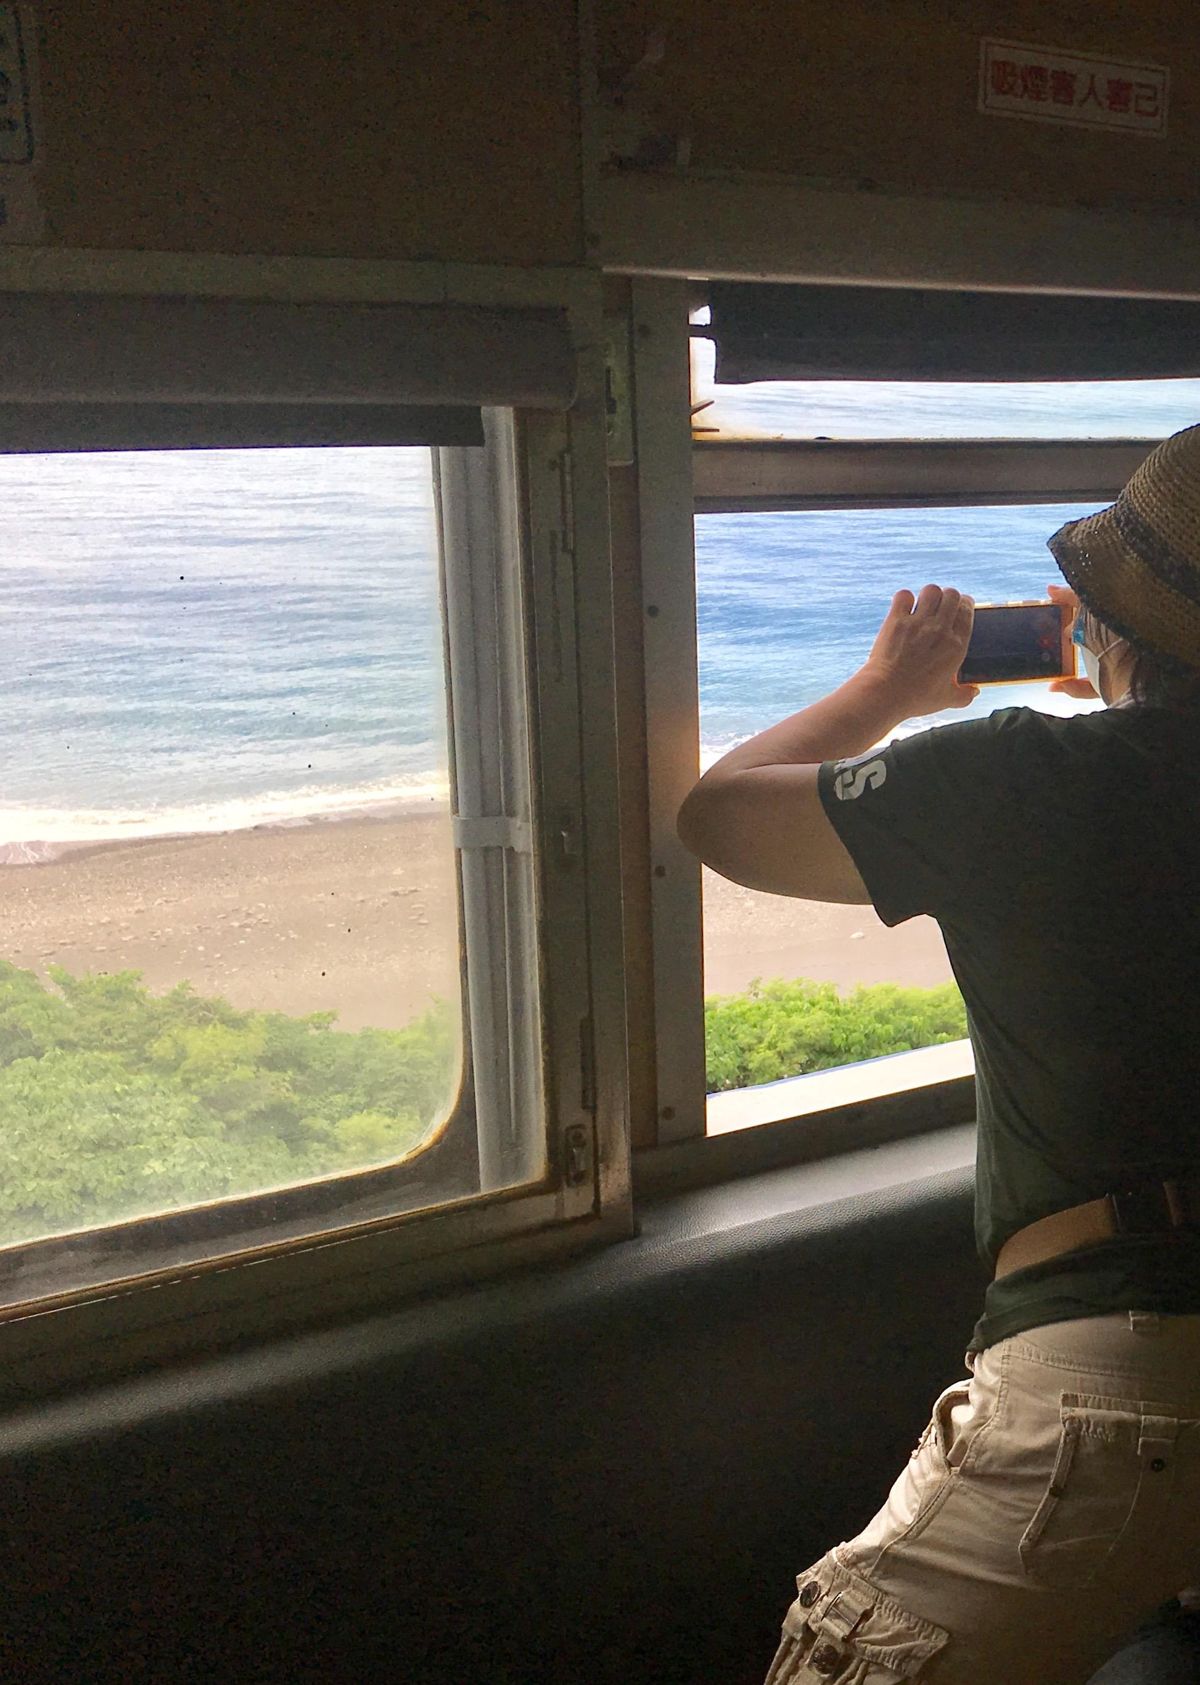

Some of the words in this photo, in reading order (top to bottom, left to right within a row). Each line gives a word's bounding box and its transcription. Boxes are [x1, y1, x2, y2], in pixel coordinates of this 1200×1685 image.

[991, 60, 1159, 118] 吸煙害人害己
